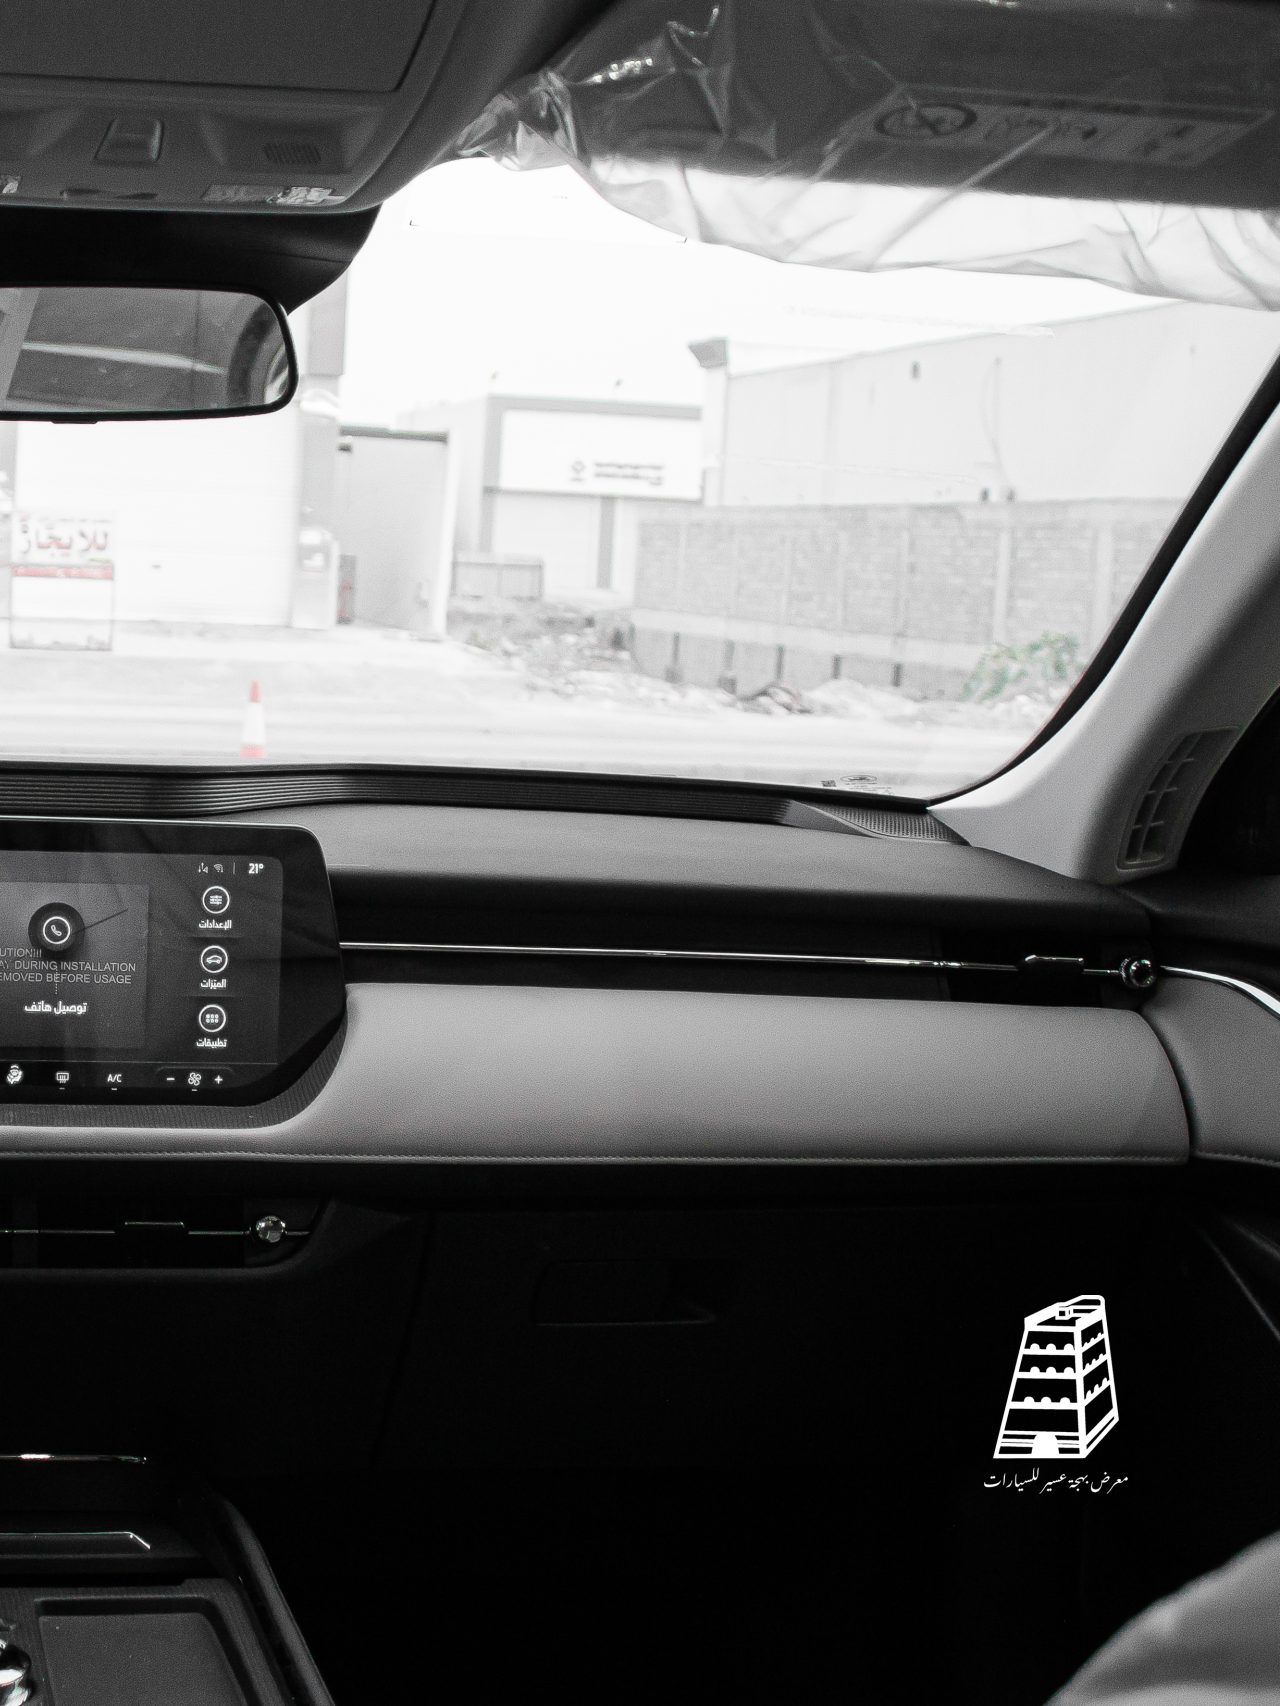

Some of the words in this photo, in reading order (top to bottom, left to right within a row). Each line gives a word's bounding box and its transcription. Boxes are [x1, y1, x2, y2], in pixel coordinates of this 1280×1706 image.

[14, 960, 58, 970] DURING
[60, 961, 136, 972] INSTALLATION
[46, 973, 91, 983] BEFORE
[94, 974, 132, 984] USAGE
[24, 1001, 52, 1013] هاتف
[54, 1001, 88, 1014] توصيل
[196, 1037, 228, 1049] تطبيقات
[107, 1073, 122, 1083] A/C
